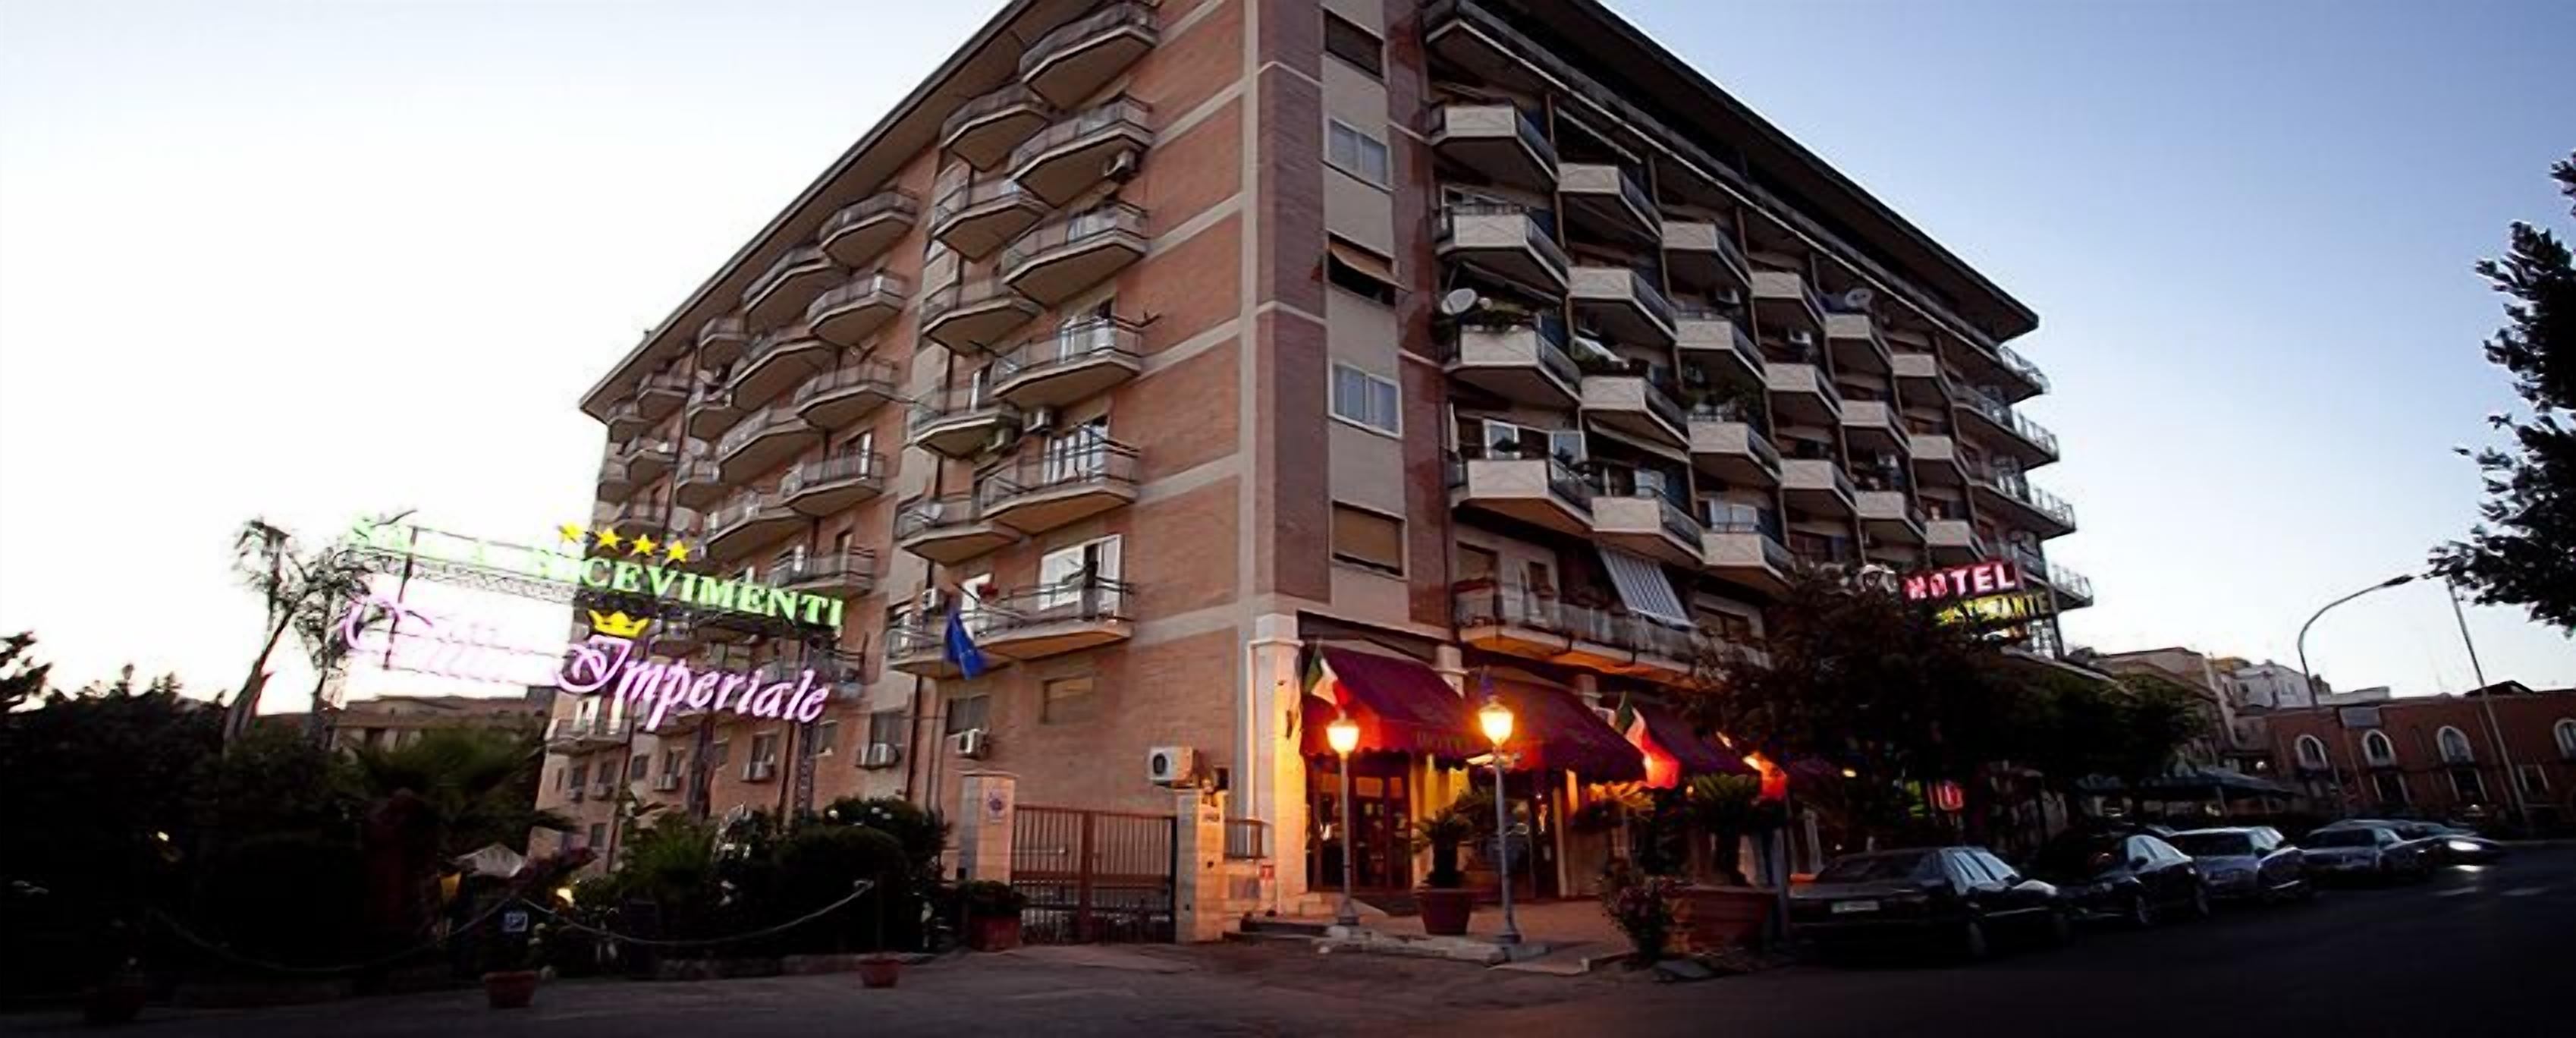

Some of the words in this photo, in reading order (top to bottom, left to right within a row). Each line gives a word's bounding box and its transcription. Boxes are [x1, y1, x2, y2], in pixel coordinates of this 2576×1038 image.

[525, 540, 843, 627] RCEVIMENTI
[1905, 562, 2016, 601] HOTEL
[556, 634, 830, 733] Imperiale
